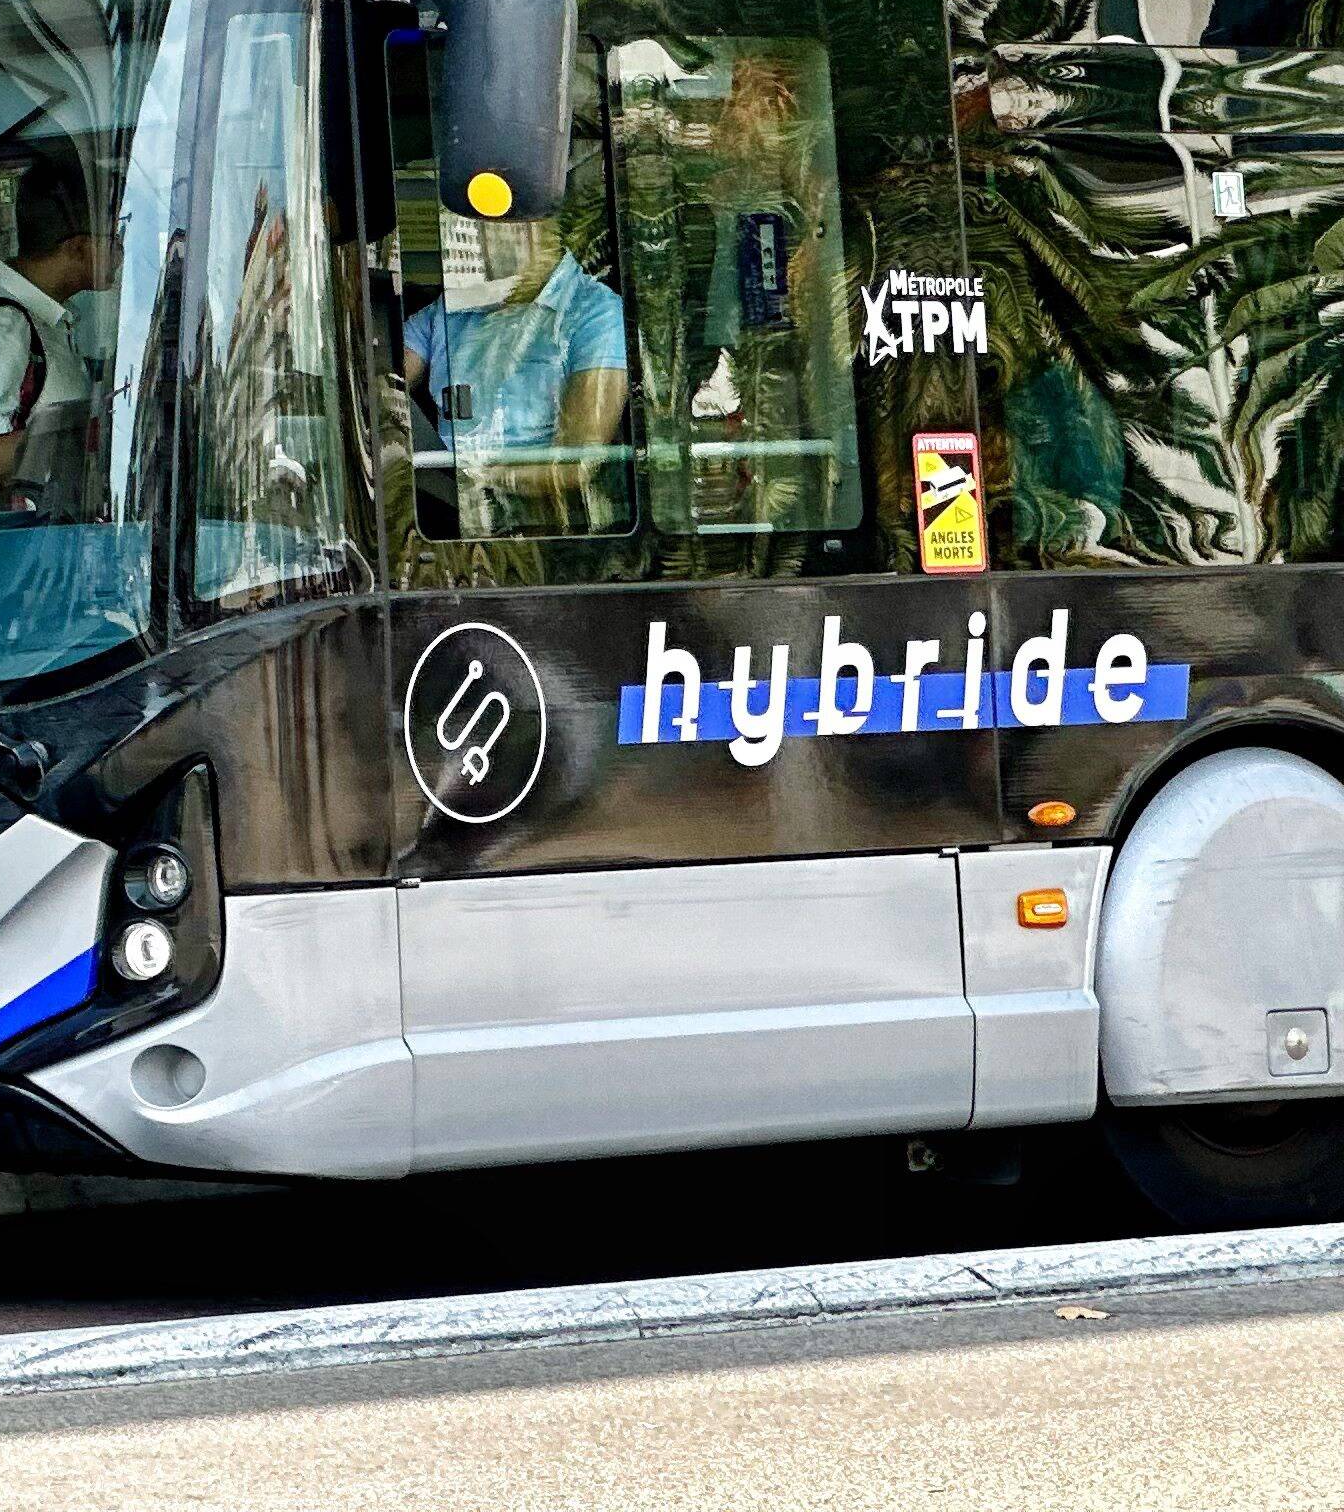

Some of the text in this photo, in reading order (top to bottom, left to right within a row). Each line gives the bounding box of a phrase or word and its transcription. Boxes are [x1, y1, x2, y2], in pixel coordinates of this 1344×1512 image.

[889, 270, 985, 297] MÉTROPOLE
[891, 301, 988, 354] TPM
[917, 438, 975, 451] ATTENTION
[930, 531, 975, 545] ANGLES
[933, 546, 974, 560] MORTS
[641, 608, 1148, 767] hybride
